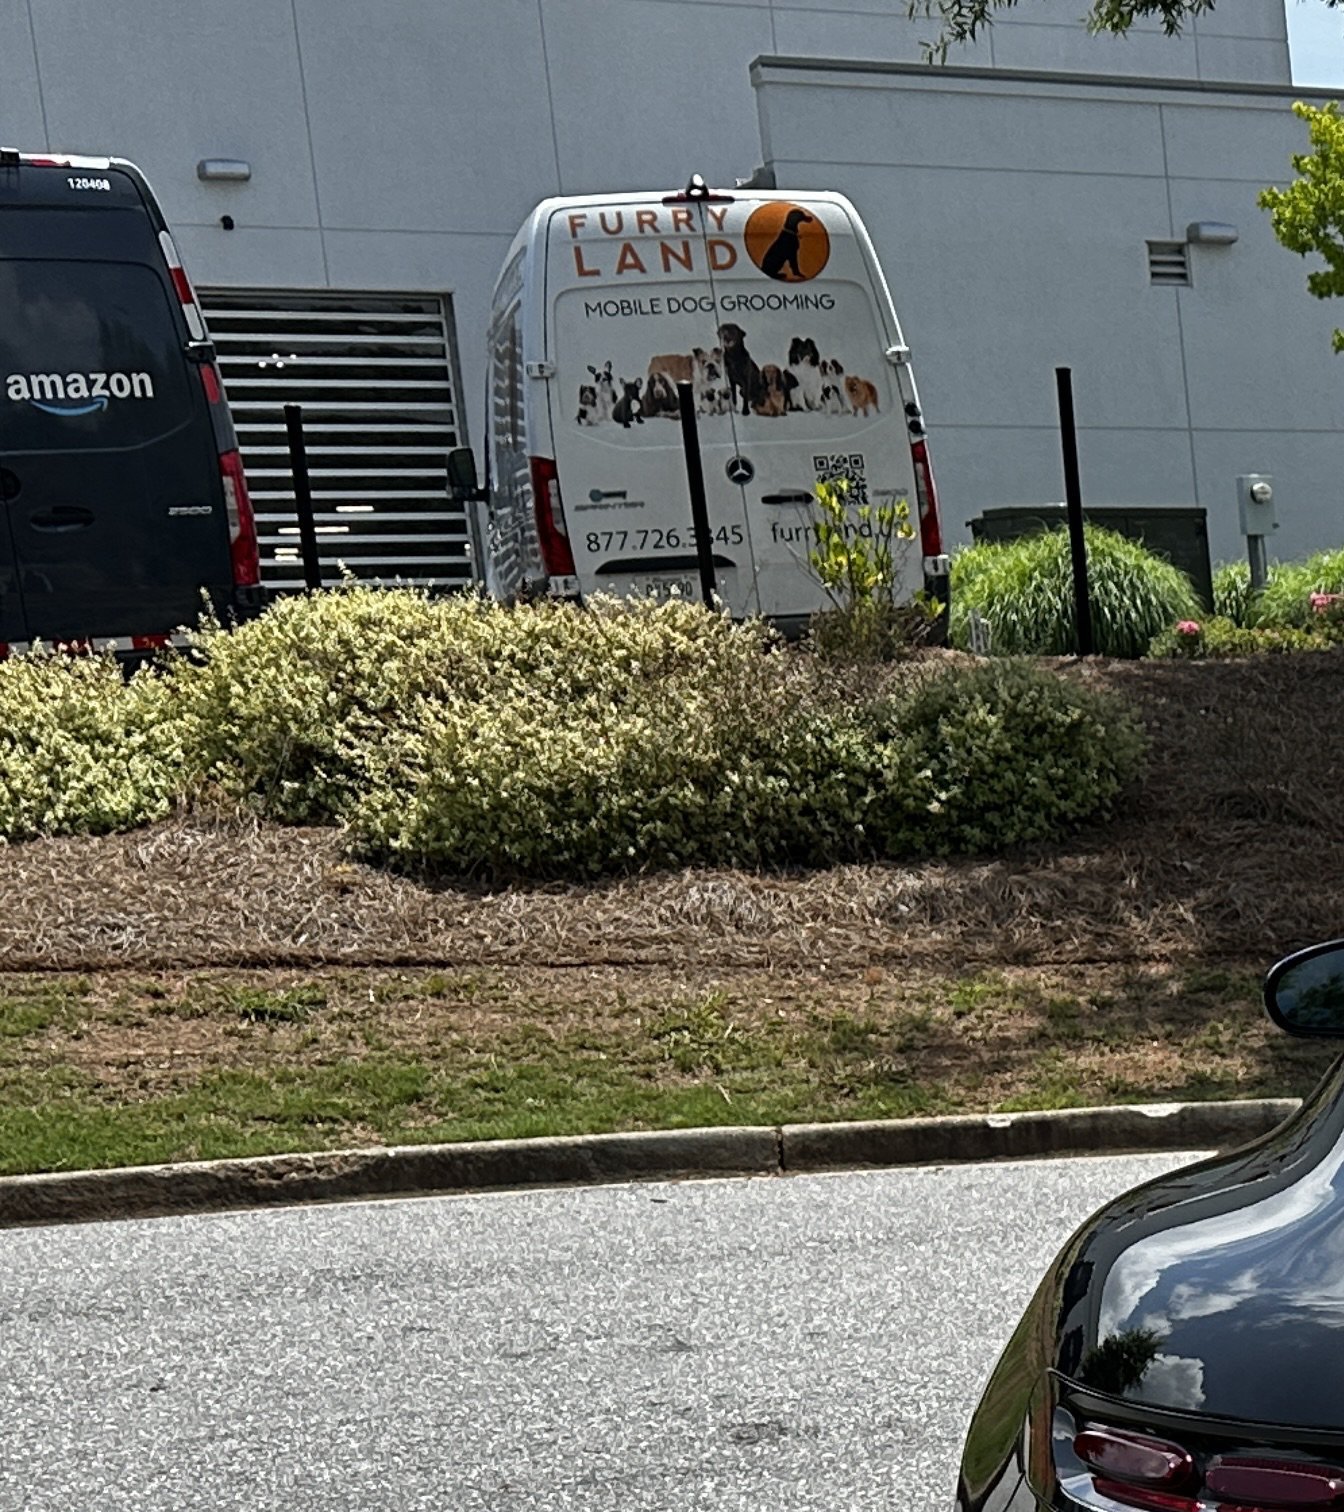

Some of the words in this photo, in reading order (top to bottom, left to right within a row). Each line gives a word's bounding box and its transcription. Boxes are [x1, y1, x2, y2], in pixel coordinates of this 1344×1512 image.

[568, 207, 728, 239] FURRY
[573, 239, 737, 277] LAND
[584, 298, 662, 318] MOBILE
[667, 296, 715, 314] DOG
[720, 293, 836, 312] GROOMING
[6, 371, 155, 400] amazon
